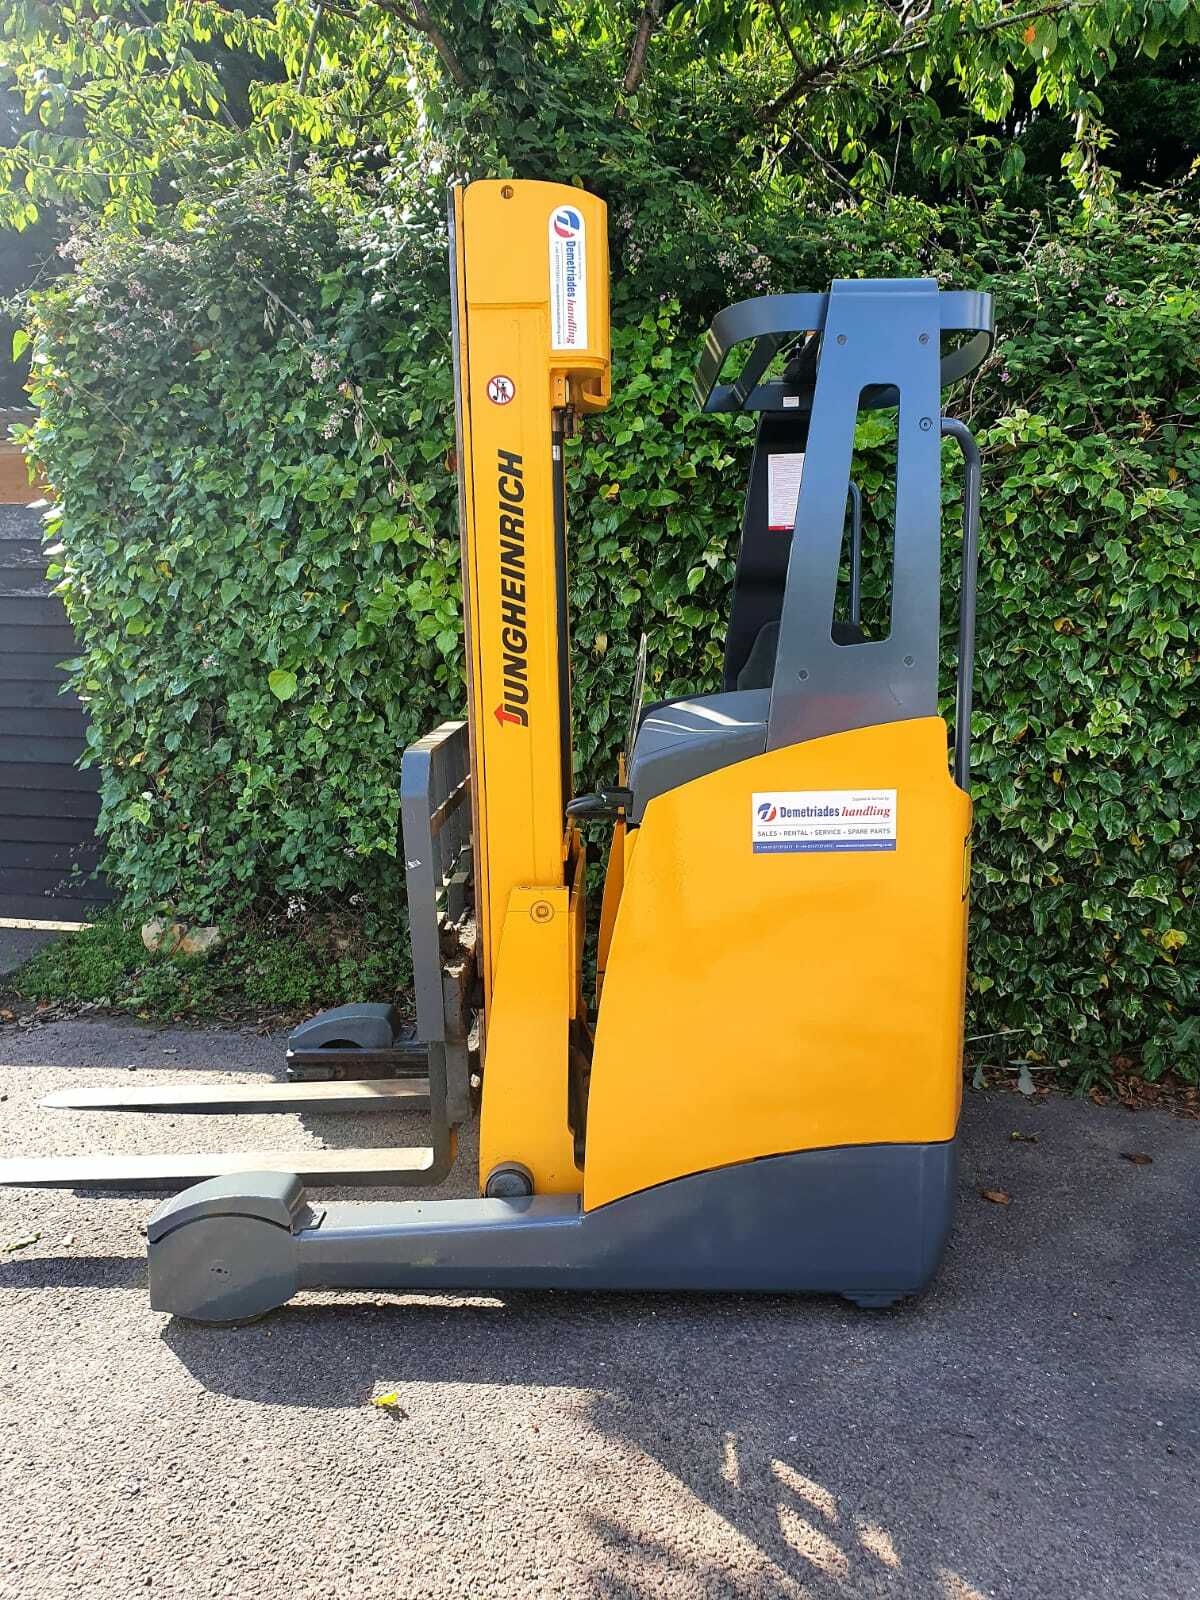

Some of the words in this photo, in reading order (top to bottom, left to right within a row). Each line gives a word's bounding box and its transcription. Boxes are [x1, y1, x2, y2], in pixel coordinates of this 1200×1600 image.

[565, 241, 577, 298] Demetriades
[566, 300, 577, 345] handling
[497, 449, 528, 728] JUNGHEINRICH
[779, 805, 840, 818] Demetriades
[841, 805, 891, 817] handling
